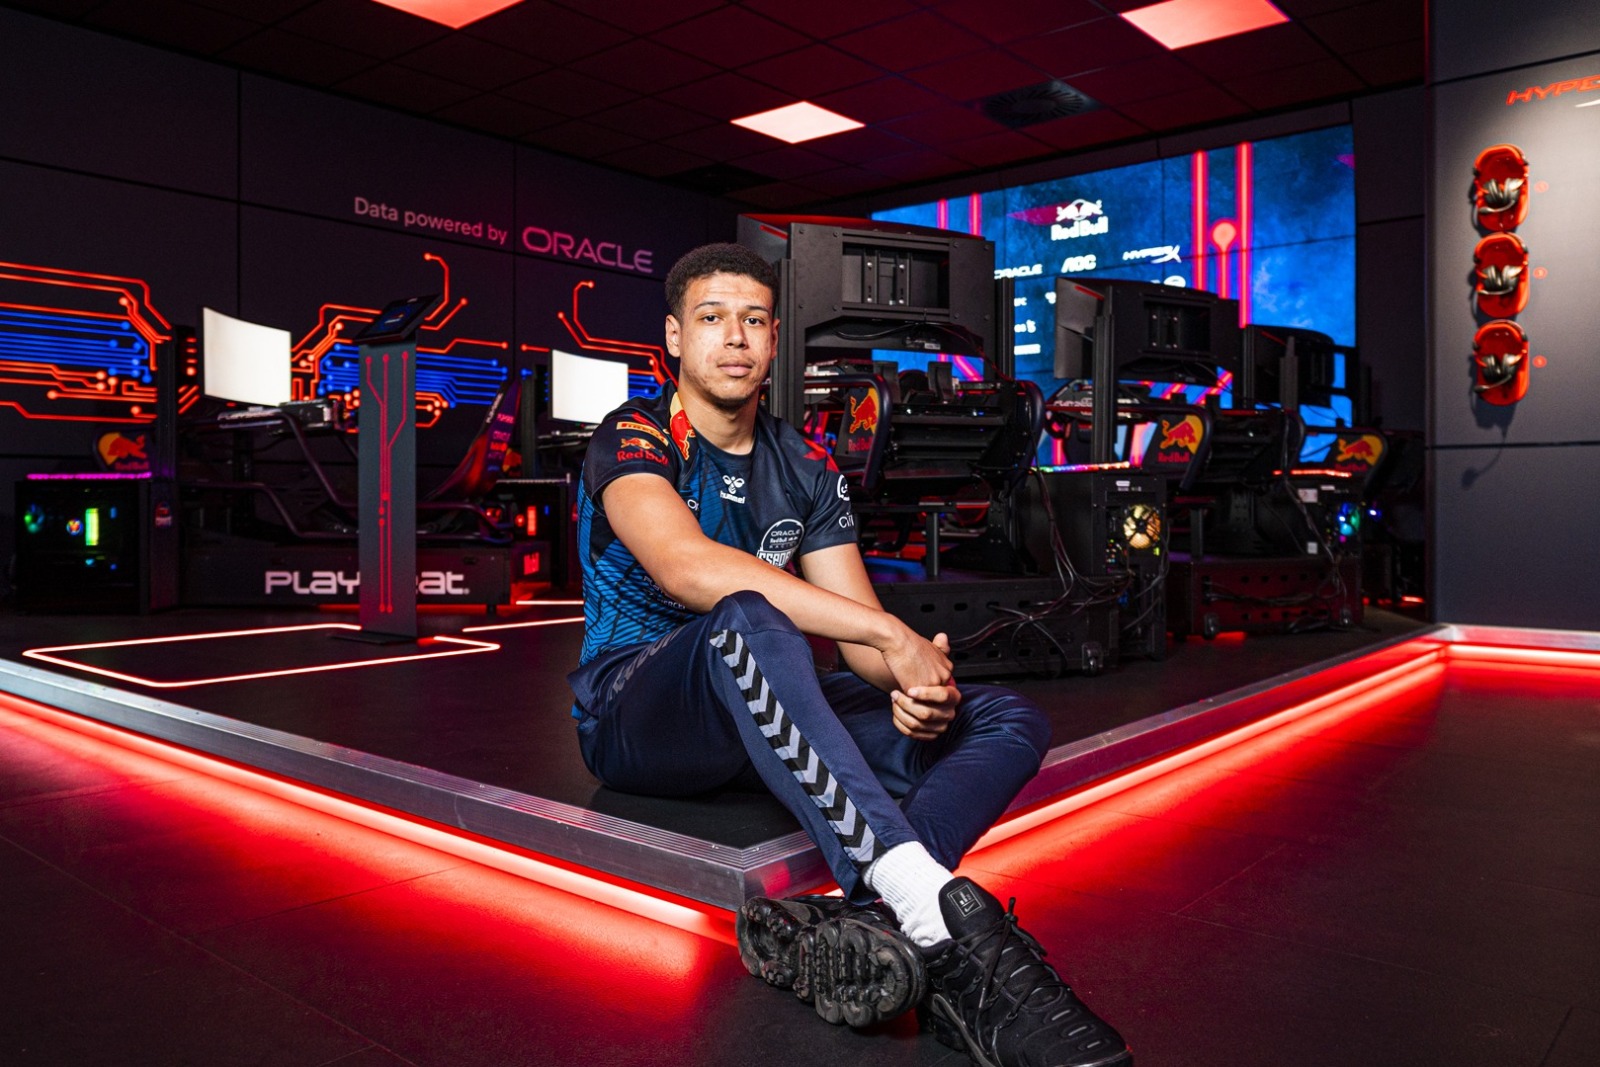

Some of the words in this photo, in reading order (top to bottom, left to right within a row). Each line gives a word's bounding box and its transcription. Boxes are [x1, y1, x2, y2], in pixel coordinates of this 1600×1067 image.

[354, 197, 398, 221] Data
[404, 210, 483, 238] powered
[487, 224, 507, 244] by
[522, 226, 653, 273] ORACLE
[1061, 254, 1097, 273] AOC
[617, 448, 644, 462] Red
[720, 490, 746, 504] hummel
[770, 529, 800, 537] ORACLE
